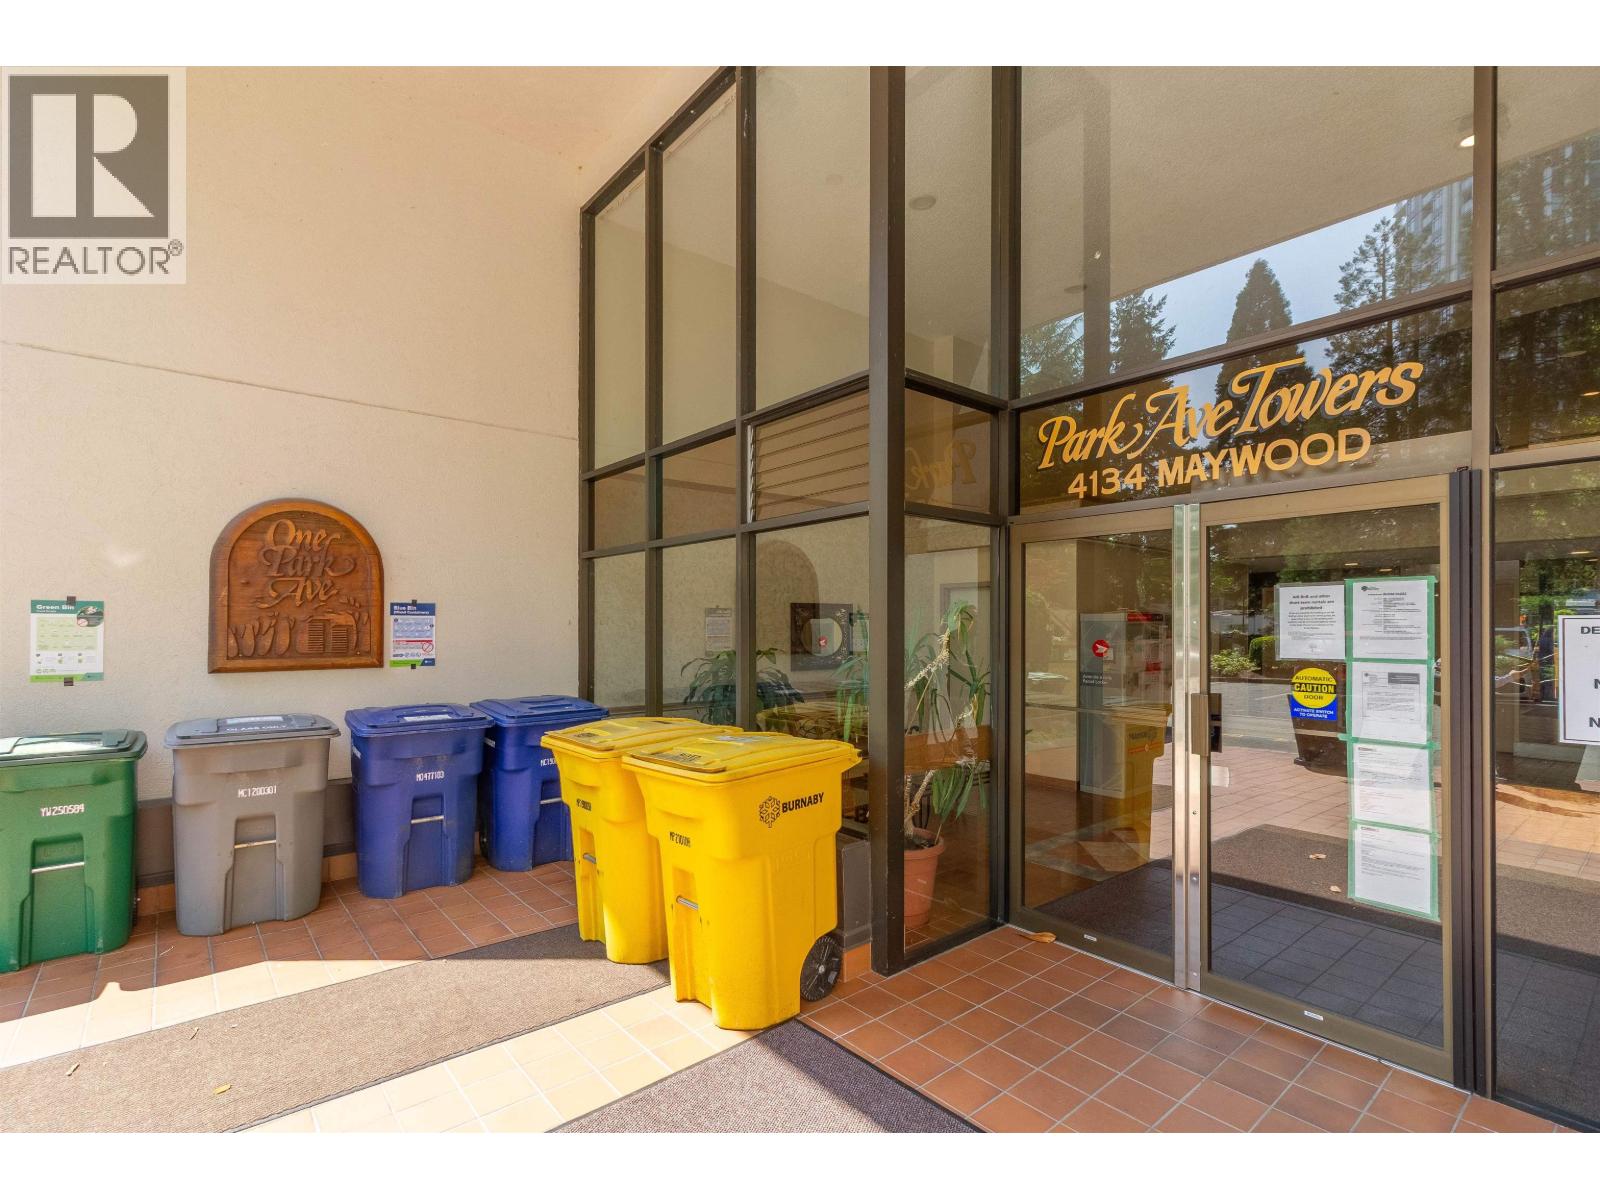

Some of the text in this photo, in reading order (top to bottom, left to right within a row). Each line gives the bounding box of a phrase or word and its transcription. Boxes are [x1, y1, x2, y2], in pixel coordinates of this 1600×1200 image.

[1038, 357, 1424, 471] Park Ave Towers
[1067, 428, 1372, 498] 4134 MAYWOOD
[266, 519, 330, 551] One
[262, 533, 357, 577] Park
[252, 576, 339, 609] Ave
[1294, 683, 1335, 693] CAUTION
[781, 792, 824, 813] BURNABY
